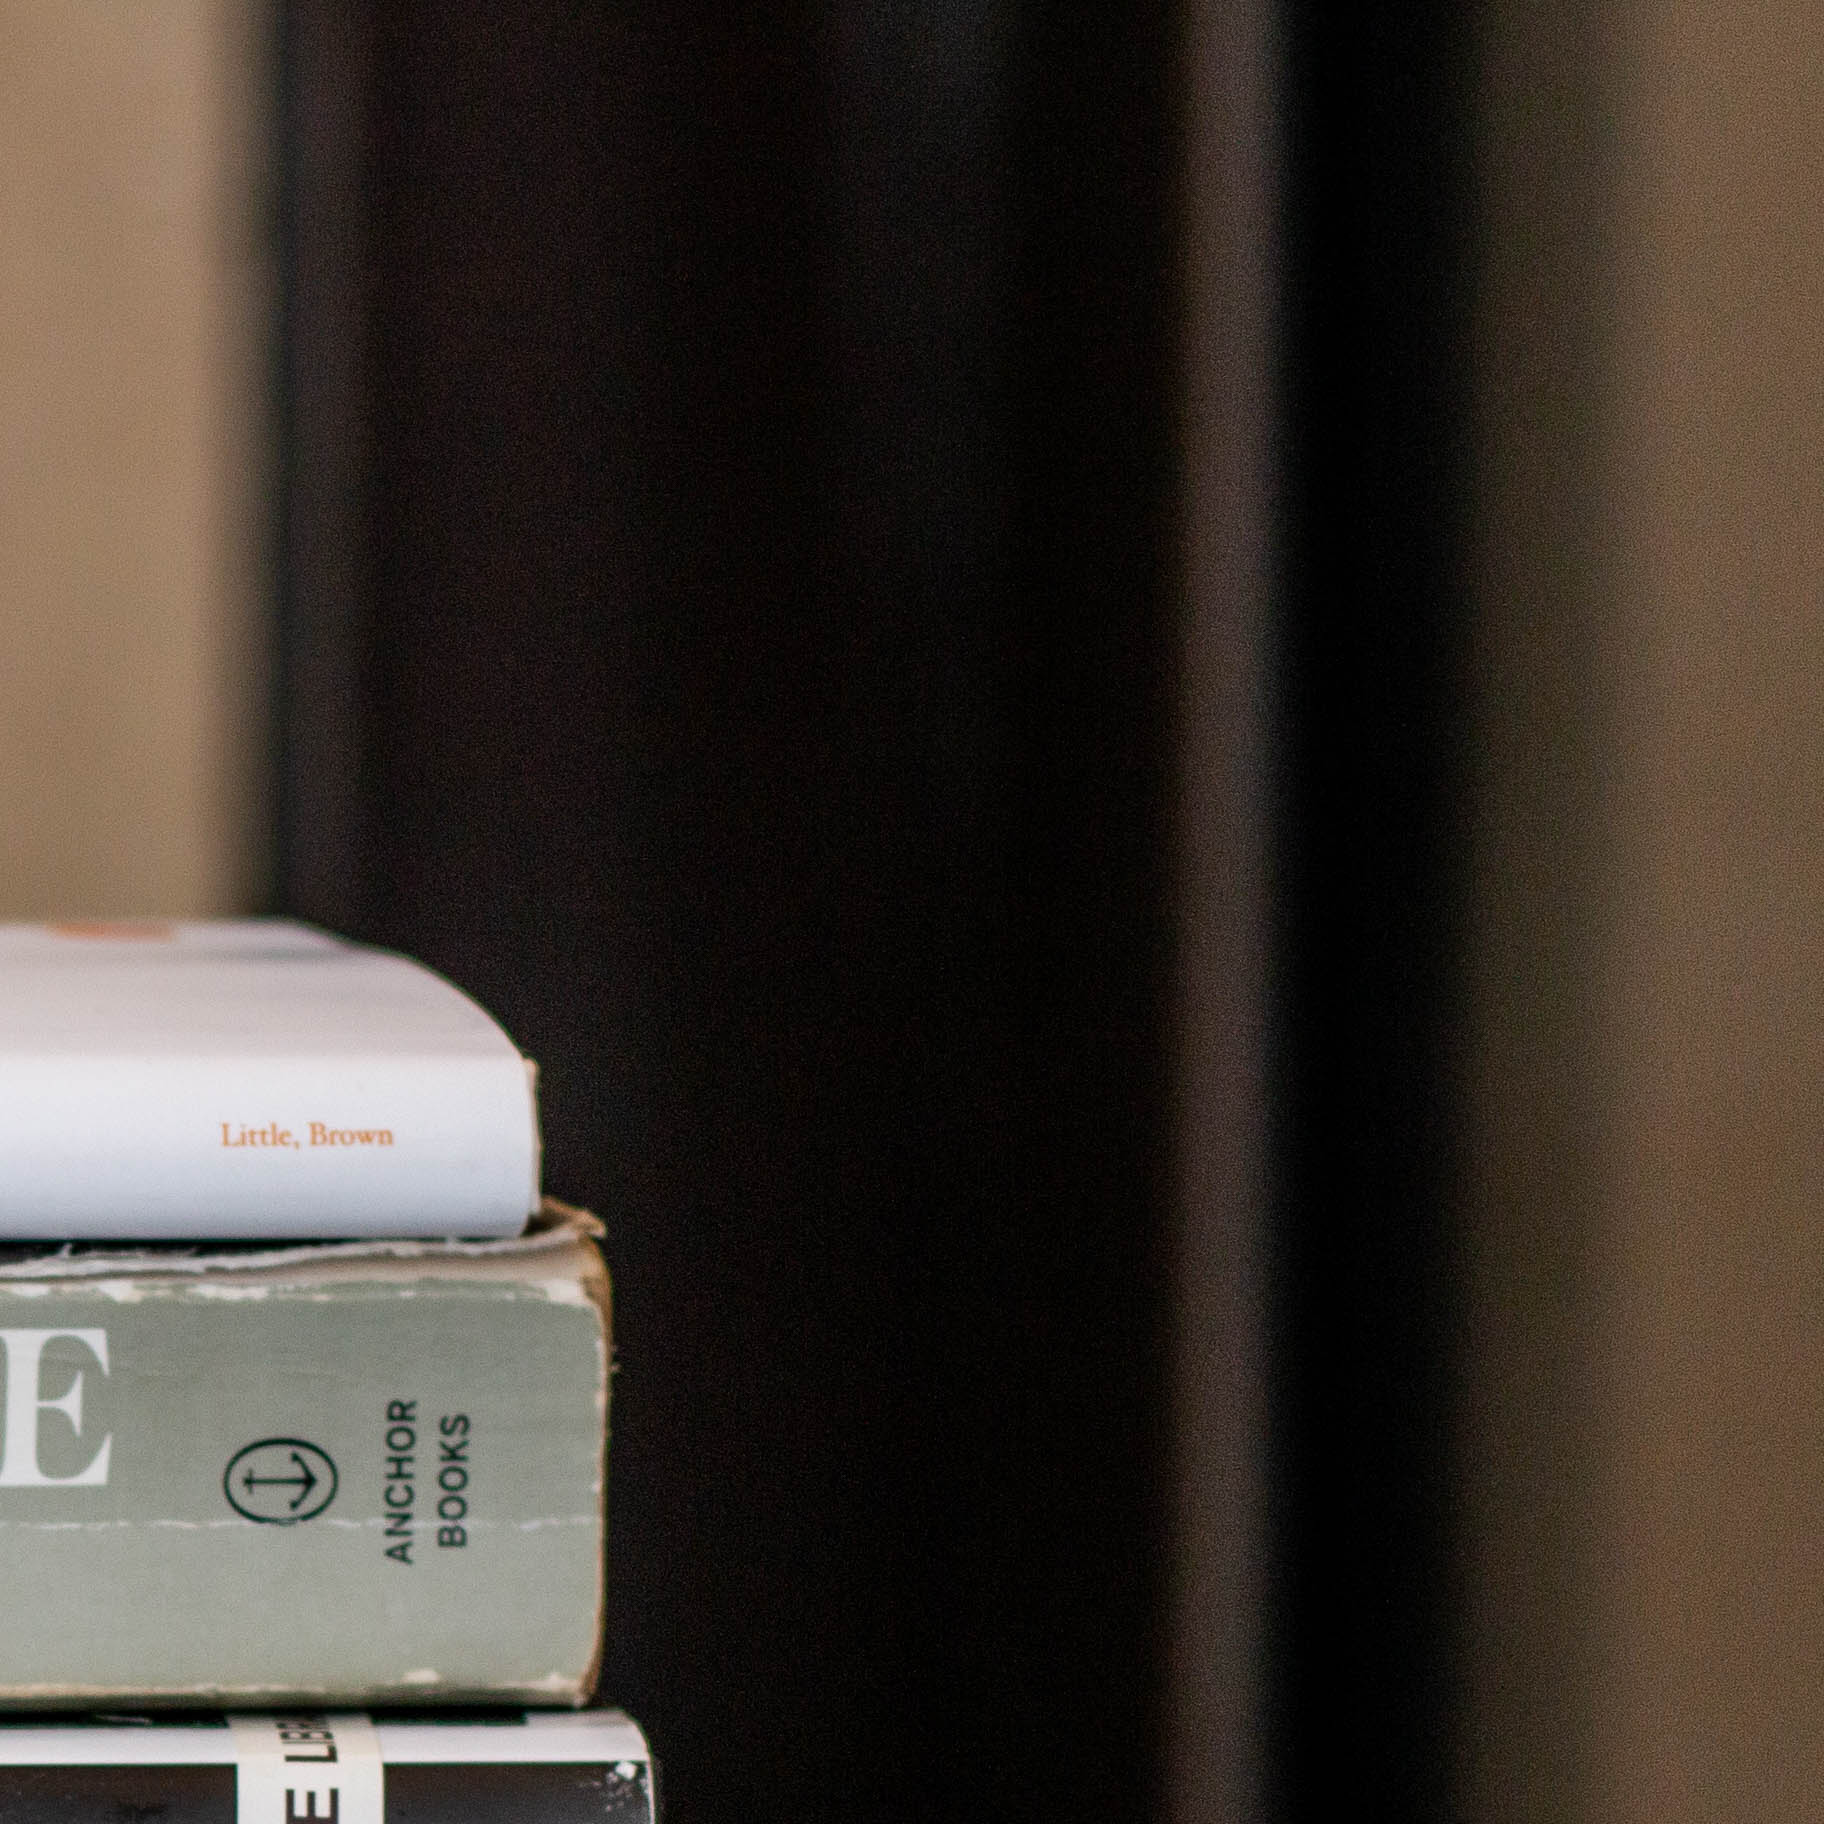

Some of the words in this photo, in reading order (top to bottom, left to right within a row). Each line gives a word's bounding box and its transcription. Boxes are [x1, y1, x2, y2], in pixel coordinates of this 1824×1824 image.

[220, 1121, 301, 1150] Little,
[308, 1121, 394, 1147] Brown
[384, 1398, 417, 1566] ANCHOR
[437, 1412, 471, 1550] BOOKS
